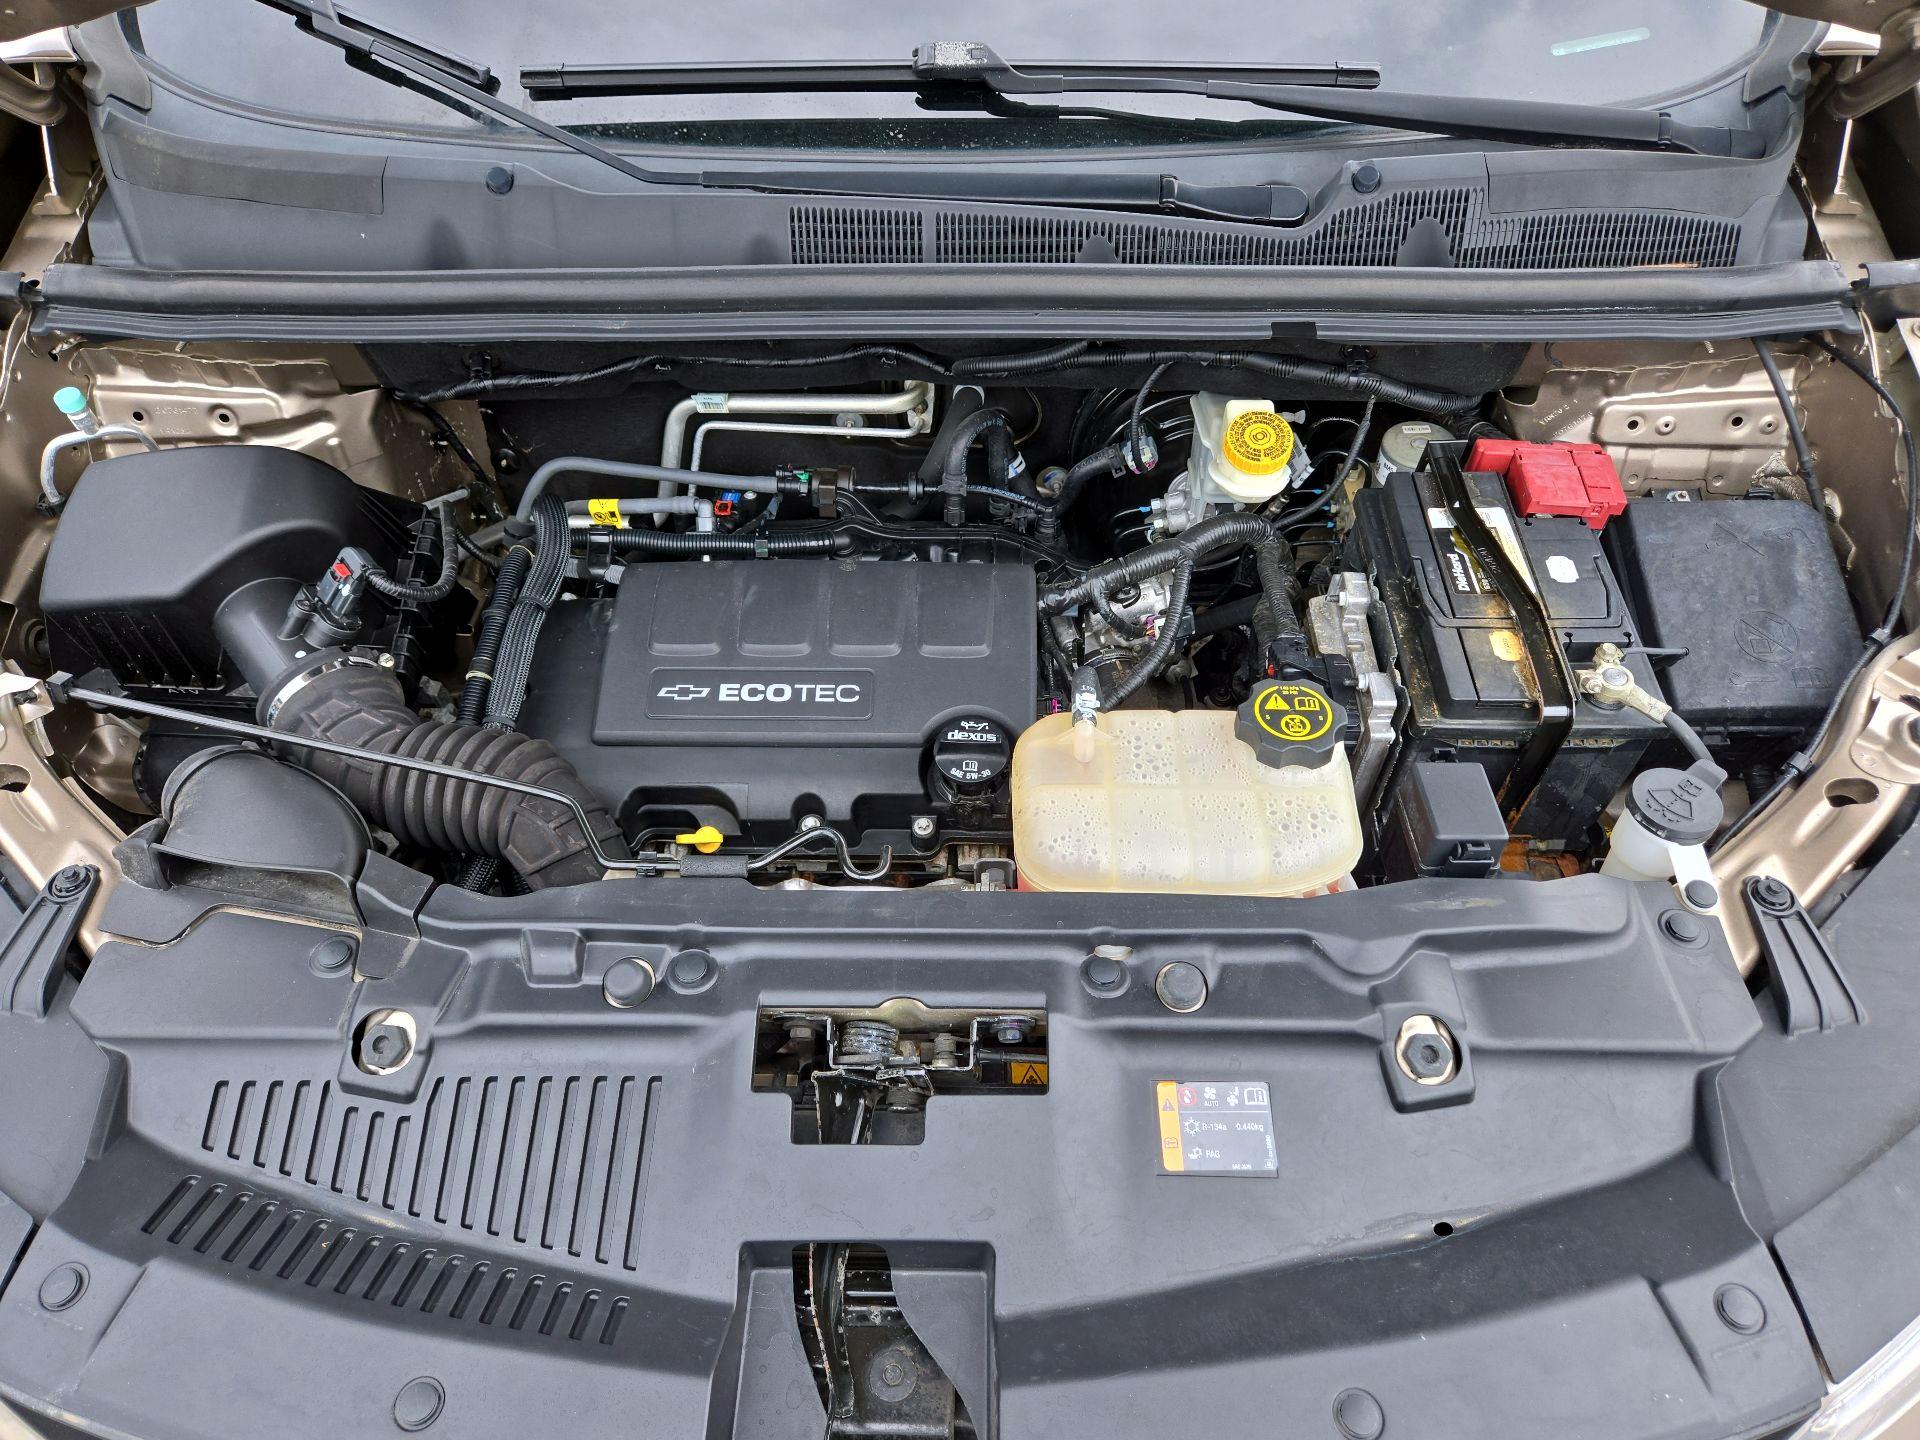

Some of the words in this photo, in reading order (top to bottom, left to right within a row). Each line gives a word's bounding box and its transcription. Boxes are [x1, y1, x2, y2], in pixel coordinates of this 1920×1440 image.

[1447, 553, 1471, 591] DieHard
[718, 683, 861, 702] ECOTEC
[947, 729, 997, 742] dexos
[950, 767, 965, 779] SAE
[965, 768, 991, 780] 5W-30
[1202, 1122, 1228, 1131] R-134a
[1206, 1150, 1221, 1159] PAG
